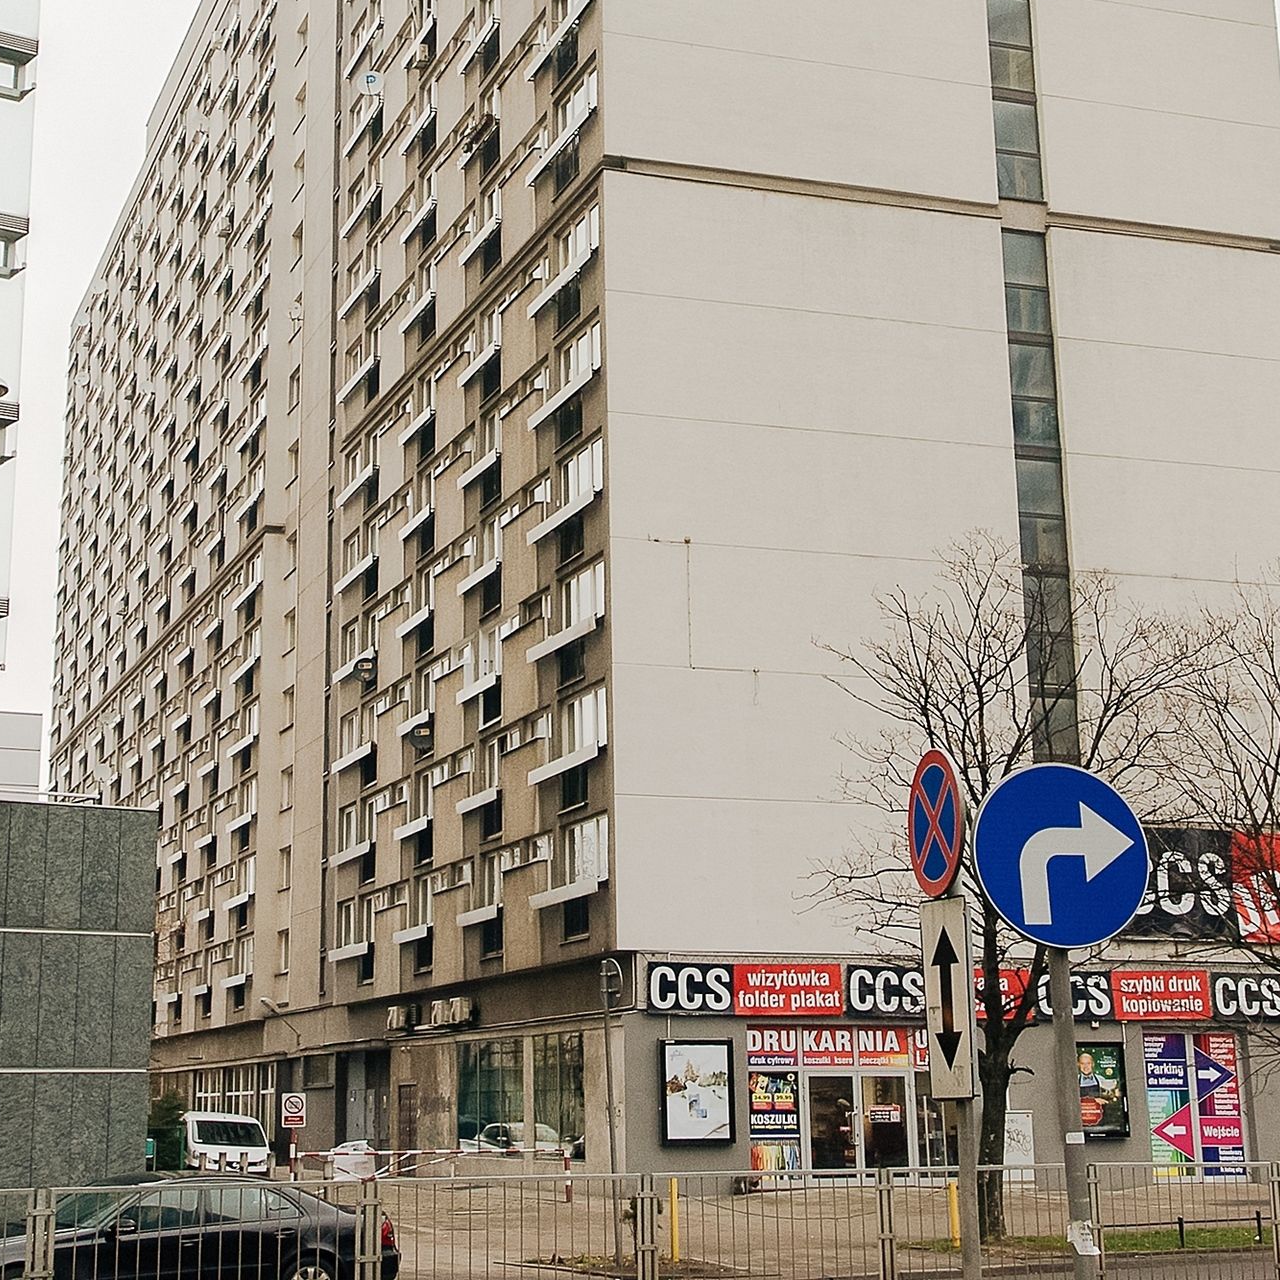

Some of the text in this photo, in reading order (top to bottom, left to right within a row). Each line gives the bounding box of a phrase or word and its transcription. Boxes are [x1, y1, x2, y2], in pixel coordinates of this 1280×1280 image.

[650, 966, 731, 1010] CCS
[747, 969, 830, 990] wizytówka
[1120, 975, 1201, 996] szybki druk
[850, 969, 925, 1013] CCS
[738, 991, 840, 1011] folder plakat
[1122, 996, 1203, 1015] kopiowanie
[749, 1056, 767, 1065] druk
[1147, 1063, 1184, 1076] Parking
[750, 1114, 798, 1125] KOSZULKI
[1202, 1124, 1240, 1139] Wejście
